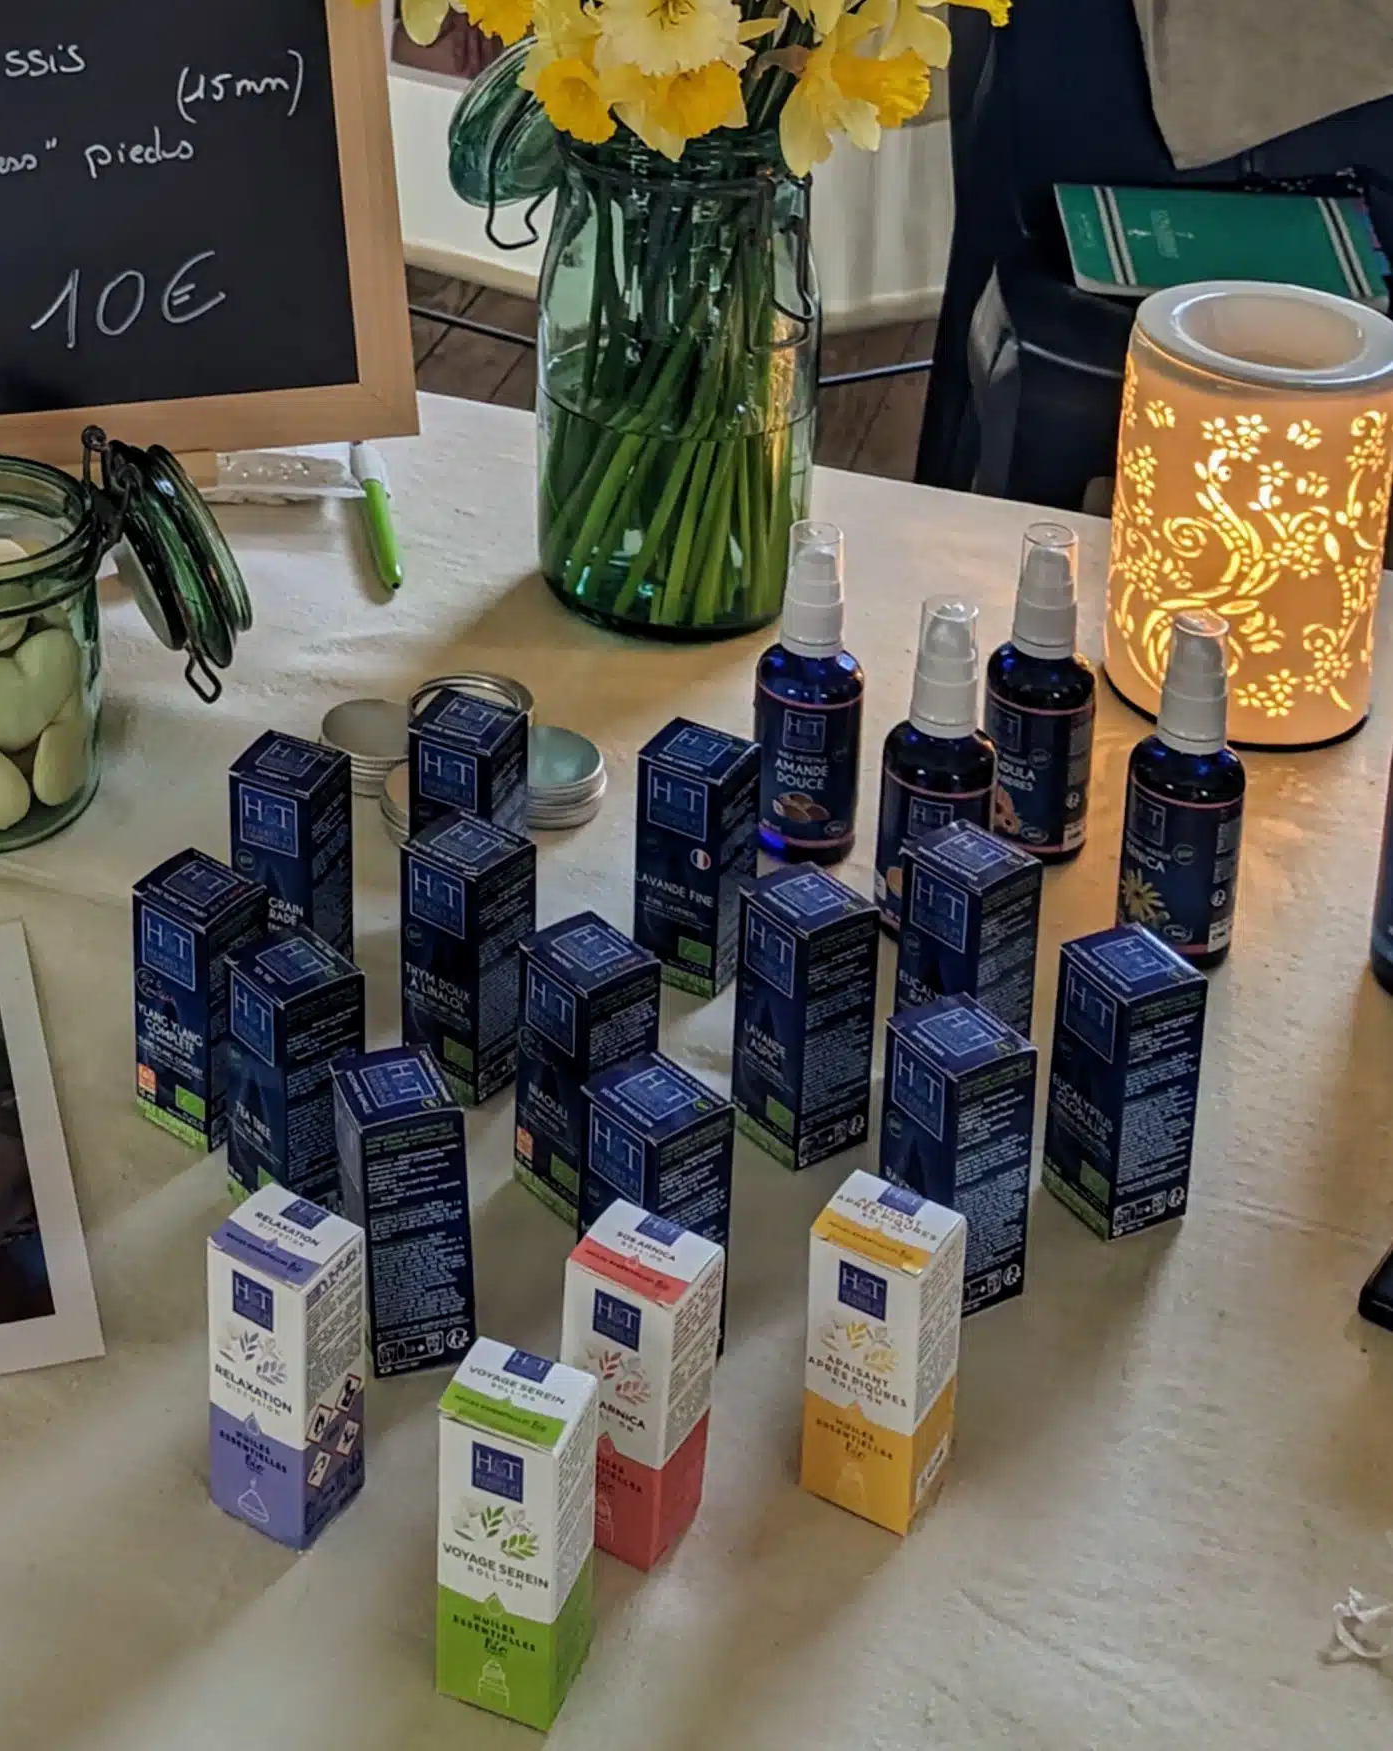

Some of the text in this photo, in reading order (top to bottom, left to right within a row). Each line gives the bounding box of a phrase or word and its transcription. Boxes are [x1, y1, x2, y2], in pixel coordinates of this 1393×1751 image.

[85, 126, 193, 178] pieds
[31, 251, 225, 348] 10€
[775, 758, 829, 777] AMANDE
[776, 771, 824, 790] DOUCE
[636, 872, 714, 908] LAVANDE FINE
[268, 909, 297, 925] RADE
[899, 969, 944, 1001] EUCALY
[255, 1211, 320, 1247] RELAXATION
[215, 1364, 293, 1414] RELAXATION
[469, 1366, 566, 1405] VOYAGE SEREIN
[599, 1400, 646, 1430] ARNICA
[443, 1541, 549, 1590] VOYAGE SEREIN
